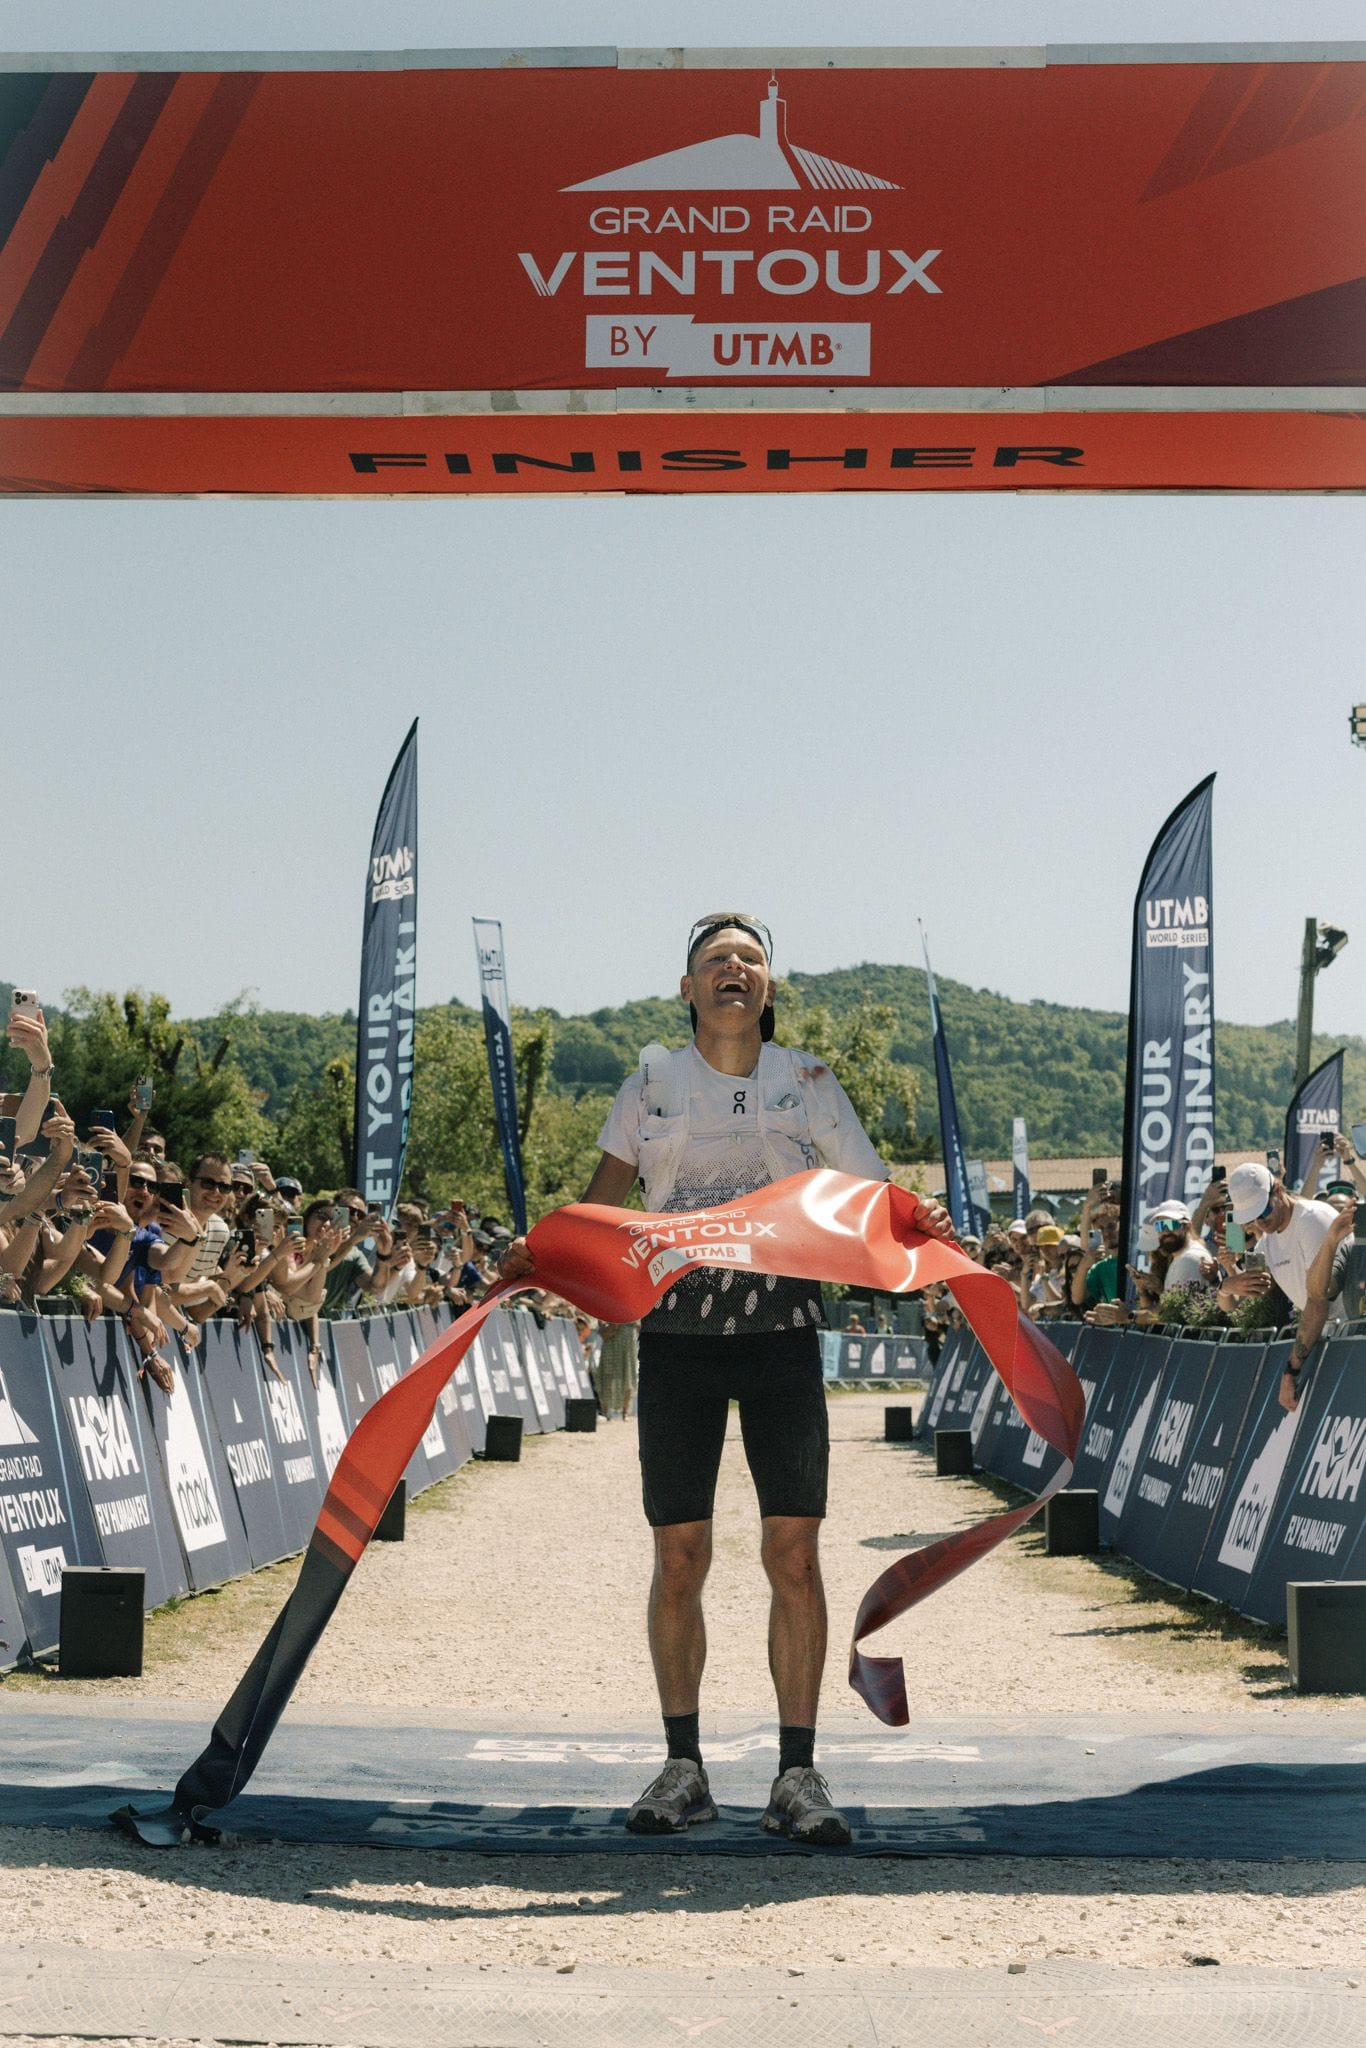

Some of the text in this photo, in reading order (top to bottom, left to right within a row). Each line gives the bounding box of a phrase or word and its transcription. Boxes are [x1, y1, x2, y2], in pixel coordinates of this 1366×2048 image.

[589, 205, 872, 235] GRAND RAID
[517, 249, 943, 296] VENTOUX
[610, 325, 657, 356] BY
[348, 446, 1088, 473] FINISHER
[1146, 896, 1208, 928] UTMB
[1149, 932, 1207, 944] WORLD SERIES
[1140, 1036, 1172, 1186] YOUR
[1296, 1109, 1339, 1124] UTMB
[629, 1218, 696, 1236] GRAND
[621, 1221, 778, 1269] VENTOUX
[652, 1246, 737, 1277] BY UTMB
[69, 1394, 141, 1481] HOKA
[227, 1438, 271, 1488] SUUNTO
[1182, 1462, 1224, 1509] SUUNTO
